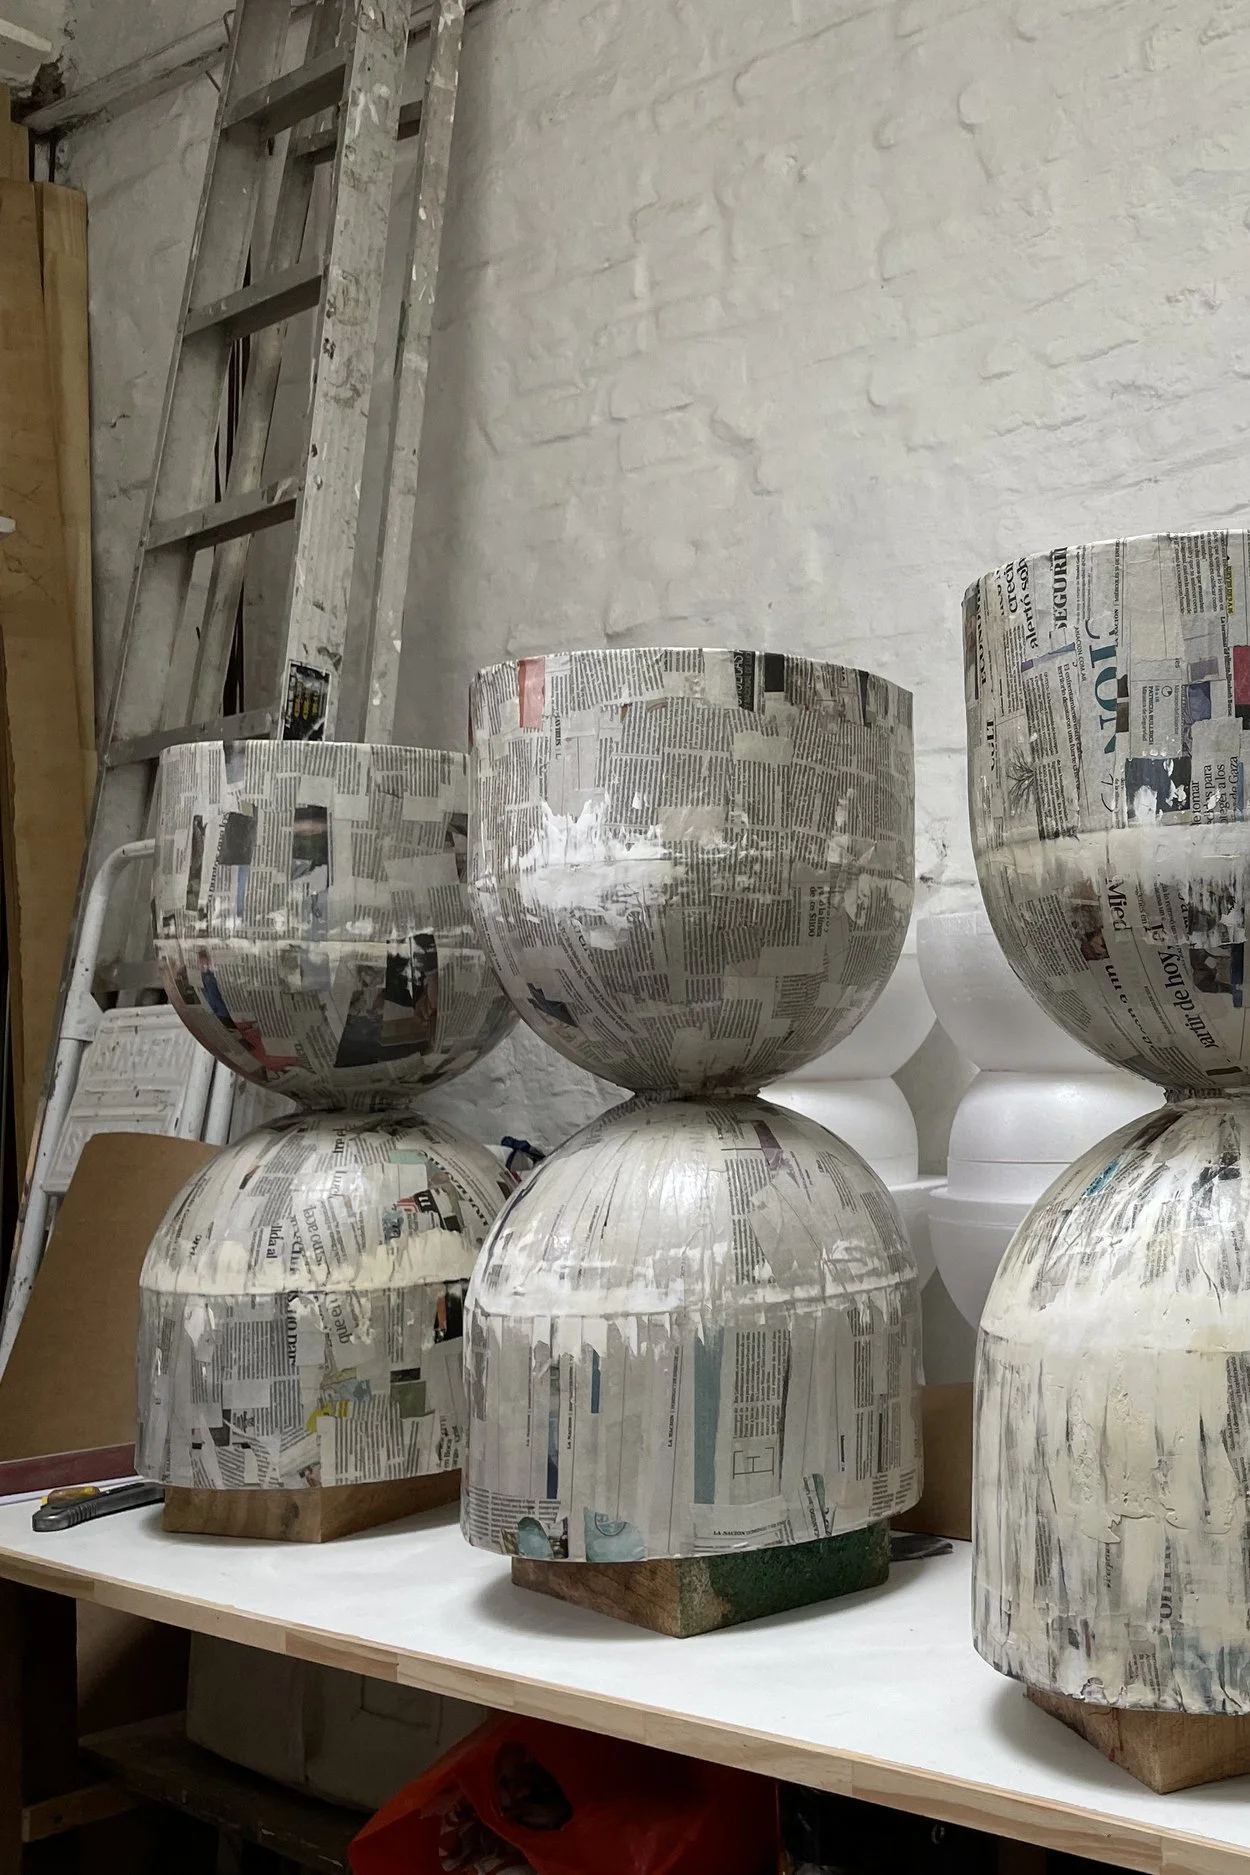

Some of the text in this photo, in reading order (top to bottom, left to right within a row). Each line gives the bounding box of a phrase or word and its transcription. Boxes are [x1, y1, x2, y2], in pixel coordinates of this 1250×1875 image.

[1020, 594, 1038, 649] alertó
[1063, 663, 1070, 671] El
[1203, 765, 1215, 789] para
[1215, 764, 1225, 780] los
[1228, 756, 1239, 784] Gaza
[1191, 781, 1201, 813] tomar
[1158, 945, 1186, 988] hoy,
[1175, 990, 1195, 1011] de
[335, 1319, 352, 1344] que
